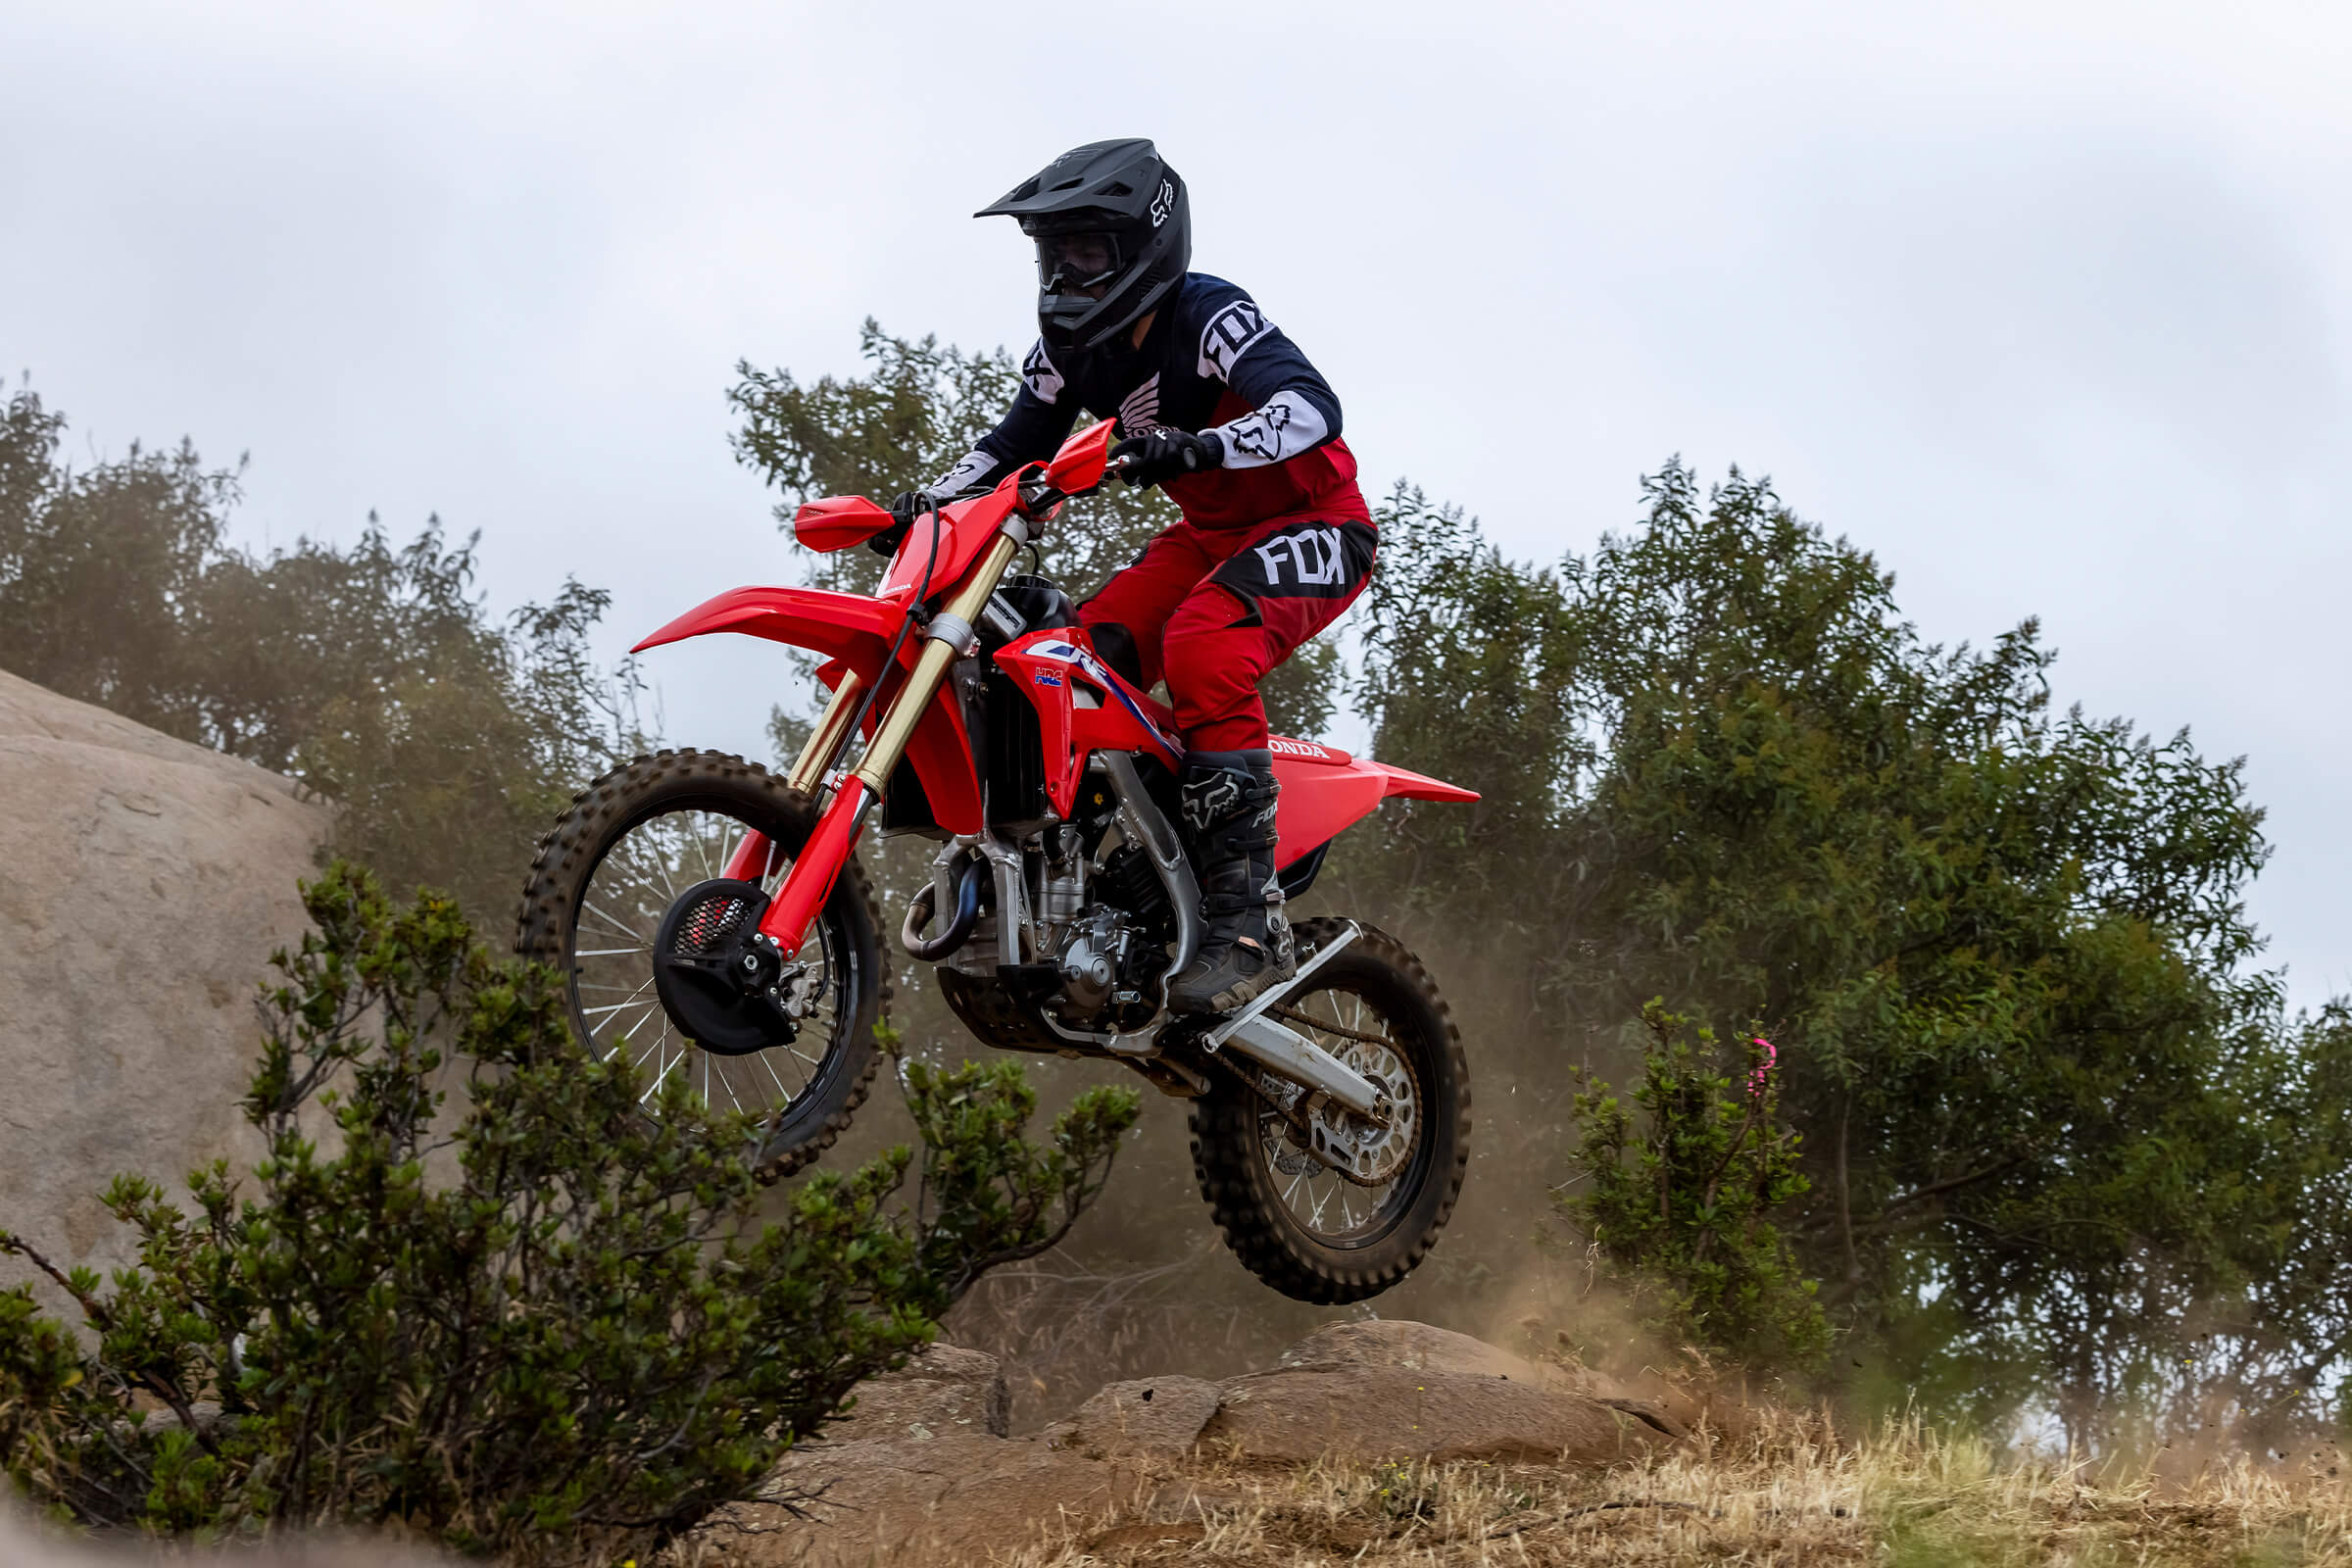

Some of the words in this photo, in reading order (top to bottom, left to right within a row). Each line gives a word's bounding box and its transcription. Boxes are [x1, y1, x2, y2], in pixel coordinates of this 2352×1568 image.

[1203, 303, 1268, 377] FOX
[1254, 527, 1345, 585] FOX
[1035, 667, 1062, 687] HRC
[1268, 739, 1331, 760] ONDA
